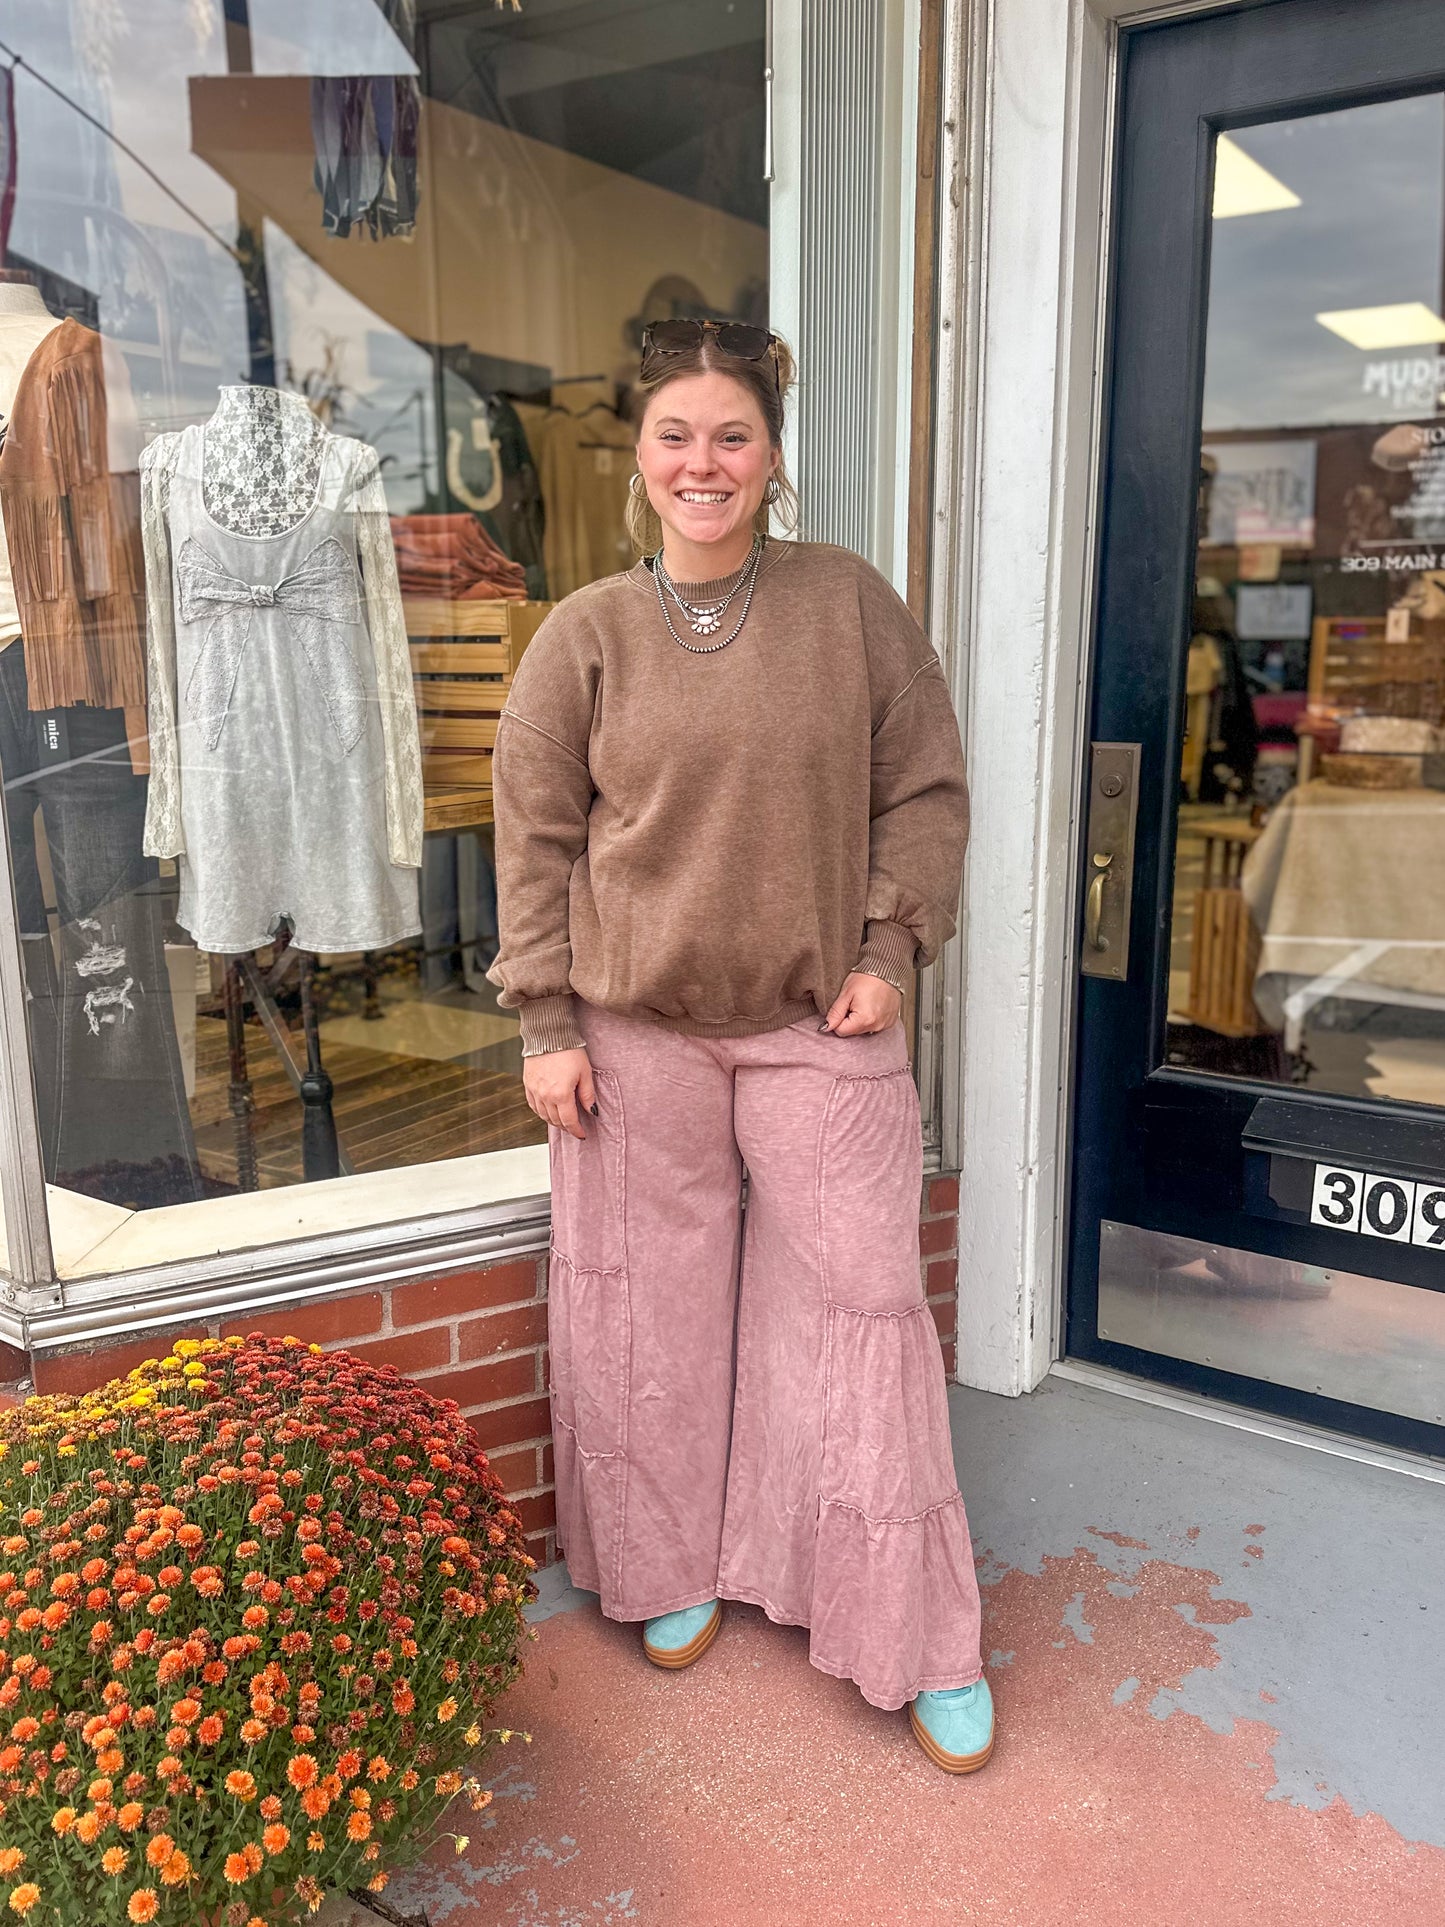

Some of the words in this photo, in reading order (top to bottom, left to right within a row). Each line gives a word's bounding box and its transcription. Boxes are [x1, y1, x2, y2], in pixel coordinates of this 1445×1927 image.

[1340, 556, 1380, 573] 309
[1384, 553, 1436, 571] MAIN
[47, 719, 59, 750] mica
